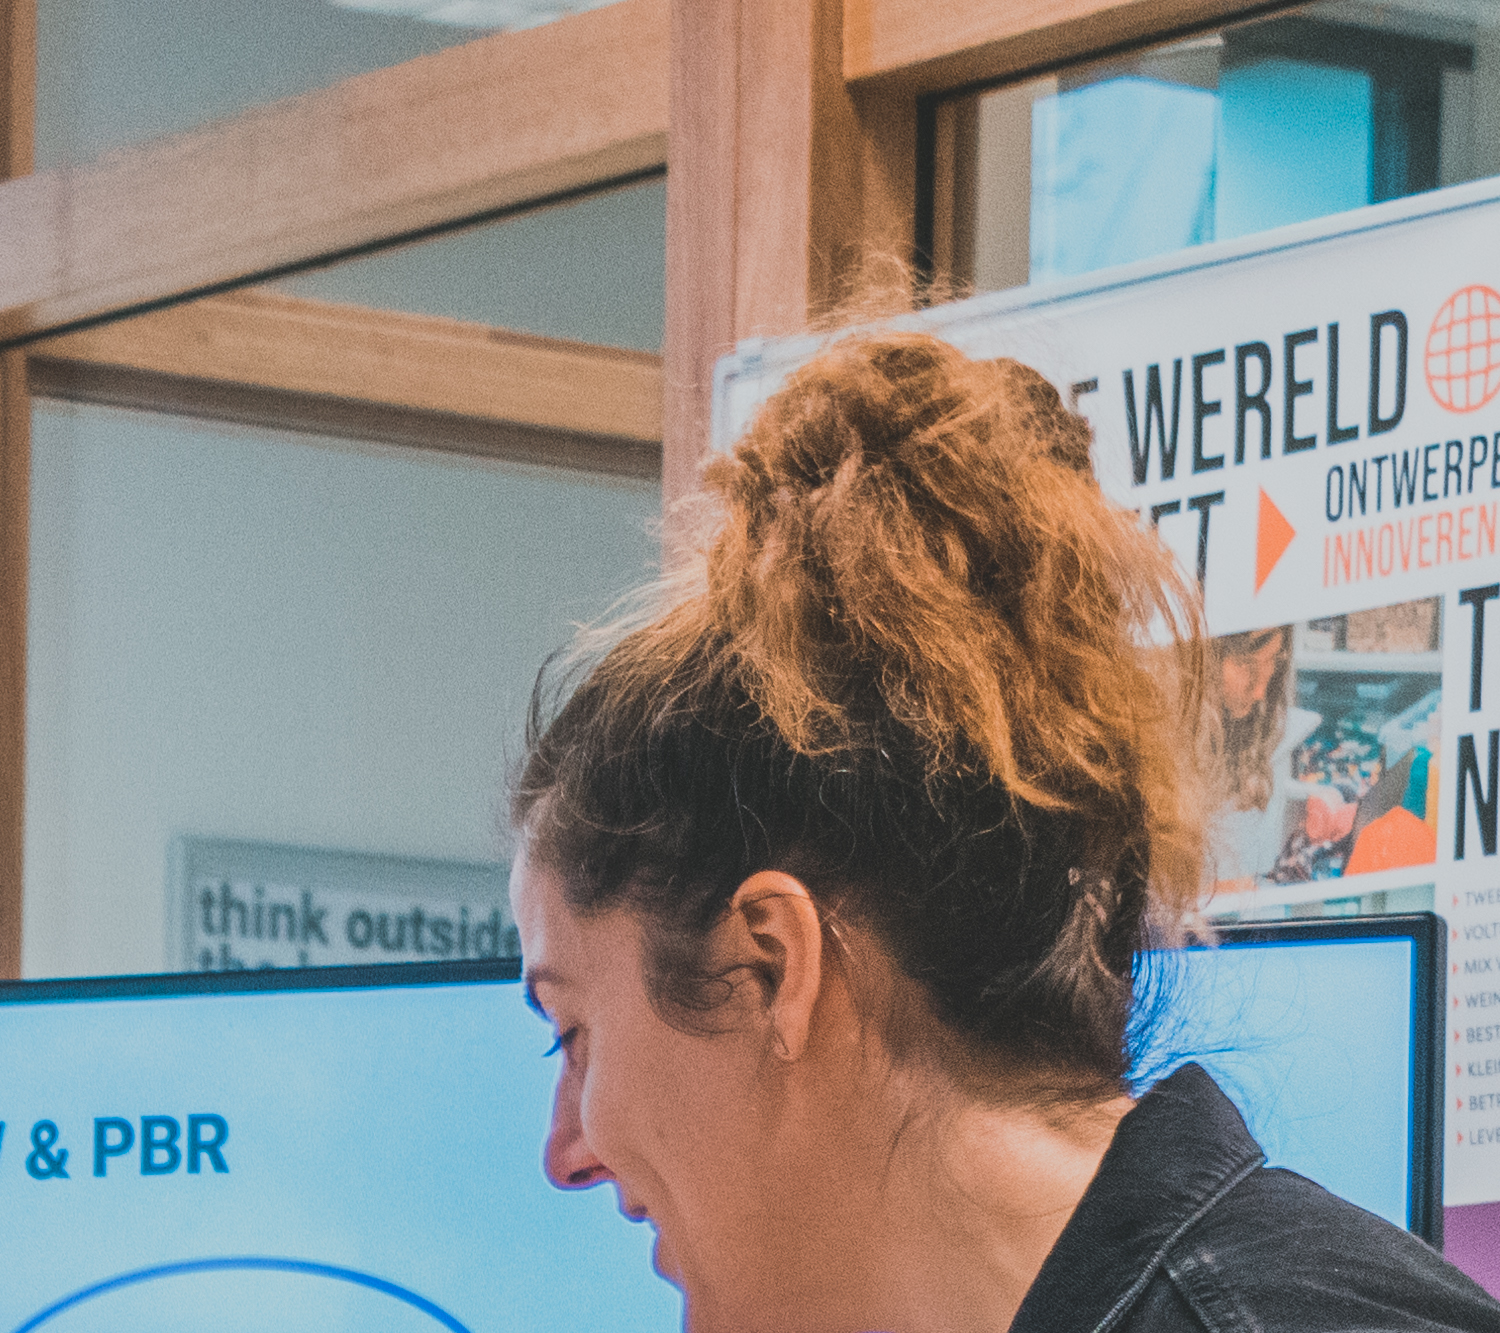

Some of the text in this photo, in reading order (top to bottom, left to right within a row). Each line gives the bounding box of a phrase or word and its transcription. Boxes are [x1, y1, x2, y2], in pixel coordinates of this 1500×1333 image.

[1122, 307, 1411, 487] WERELD
[199, 882, 329, 946] think
[345, 906, 521, 958] outside
[1464, 957, 1493, 975] MIX
[24, 1120, 71, 1180] &
[92, 1114, 231, 1177] PBR
